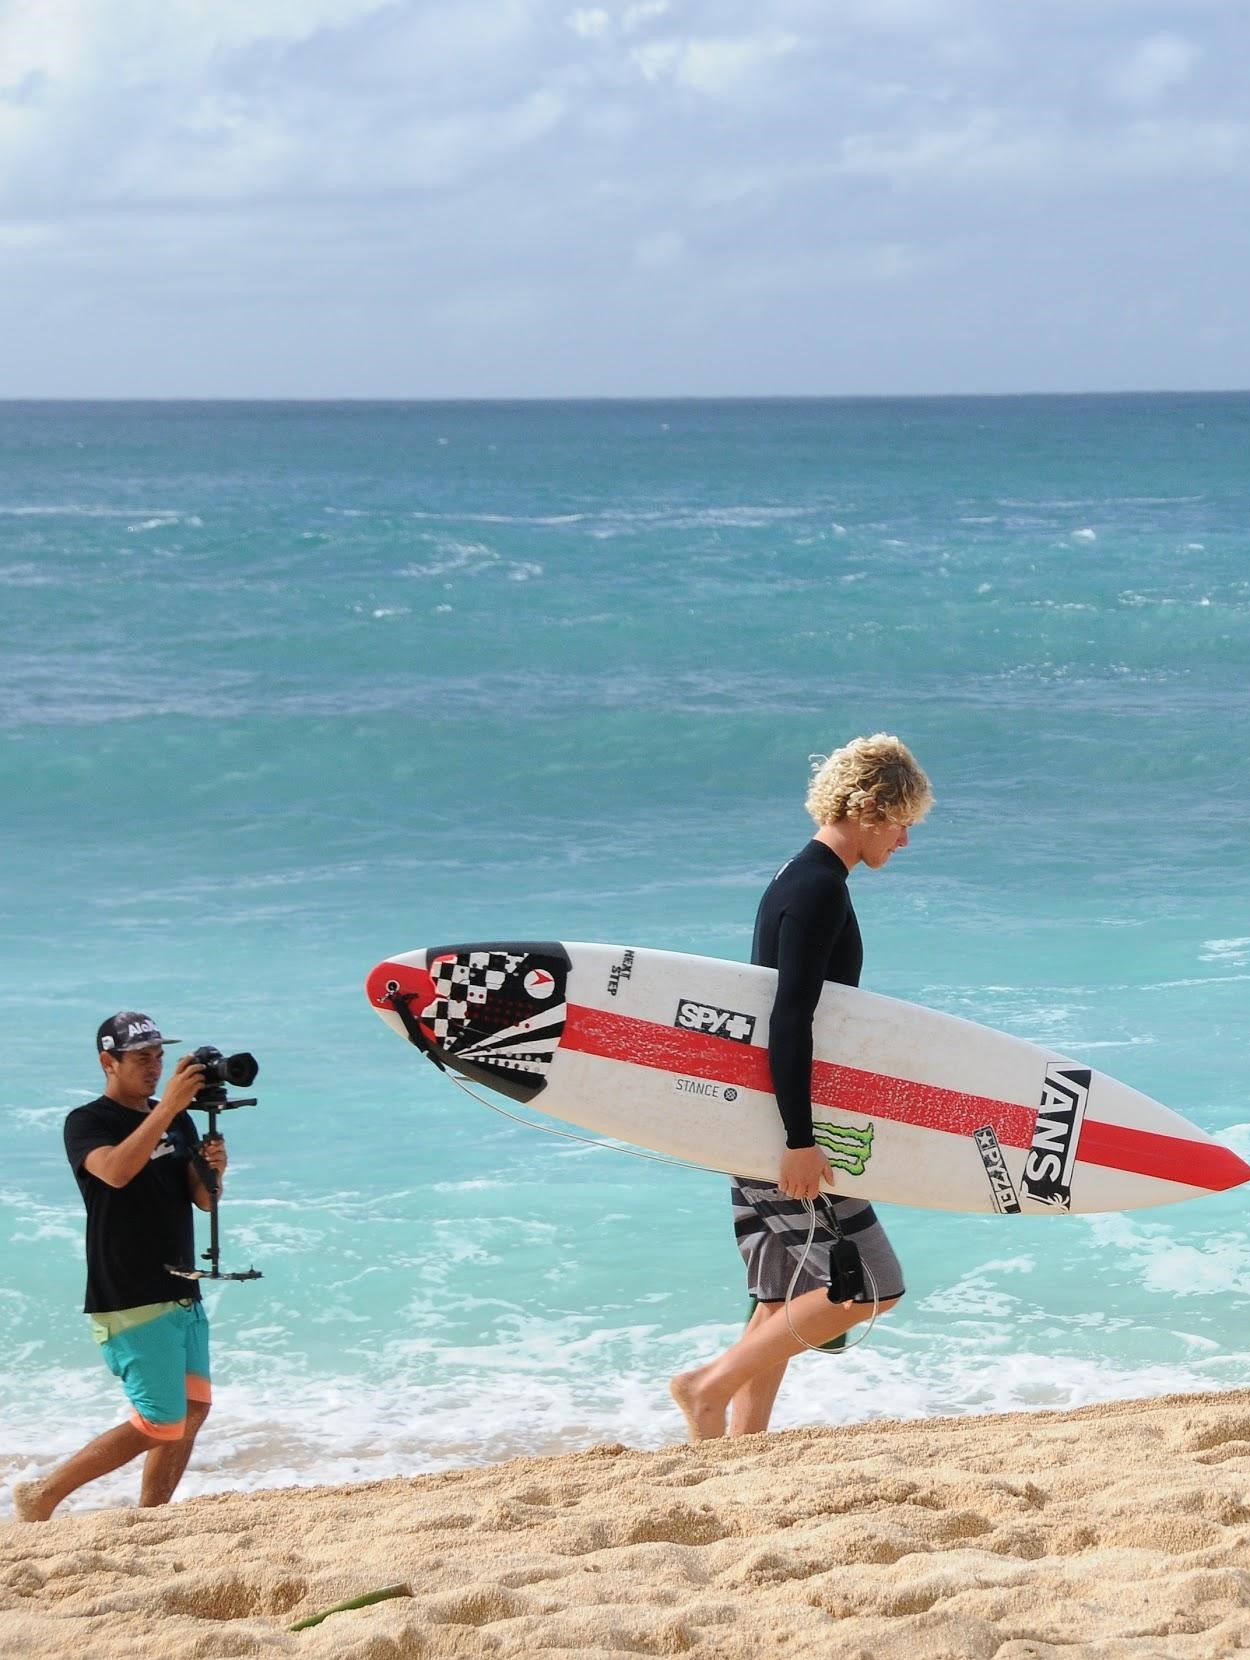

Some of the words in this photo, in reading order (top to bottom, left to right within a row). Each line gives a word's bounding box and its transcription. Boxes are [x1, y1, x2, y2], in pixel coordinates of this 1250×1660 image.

[676, 1079, 721, 1098] STANCE
[1026, 1063, 1089, 1187] VANS
[982, 1148, 1018, 1214] PYZEL
